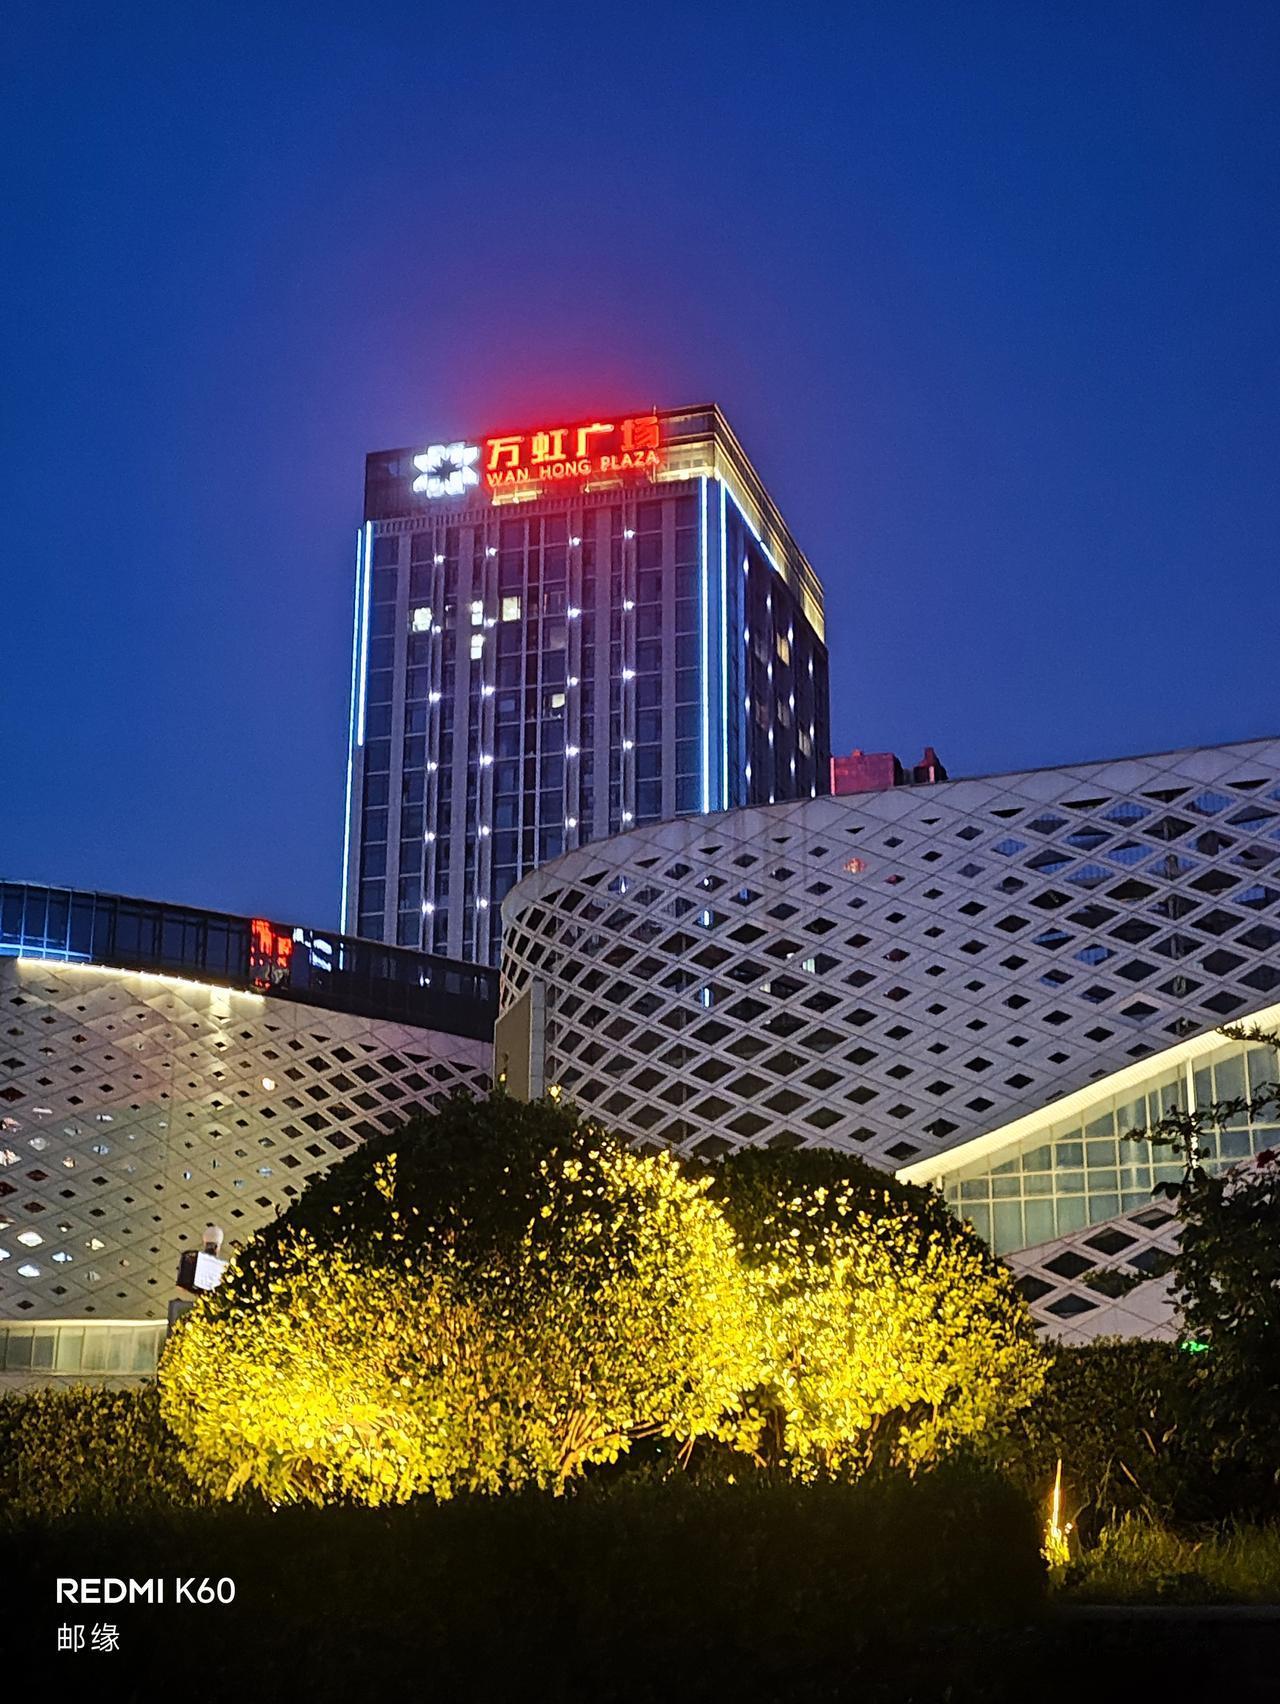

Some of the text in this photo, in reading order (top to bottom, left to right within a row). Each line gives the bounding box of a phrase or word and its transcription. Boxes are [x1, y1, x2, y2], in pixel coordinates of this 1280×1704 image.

[487, 416, 660, 469] 万虹广场
[486, 450, 660, 487] WAN HONG PLAZA
